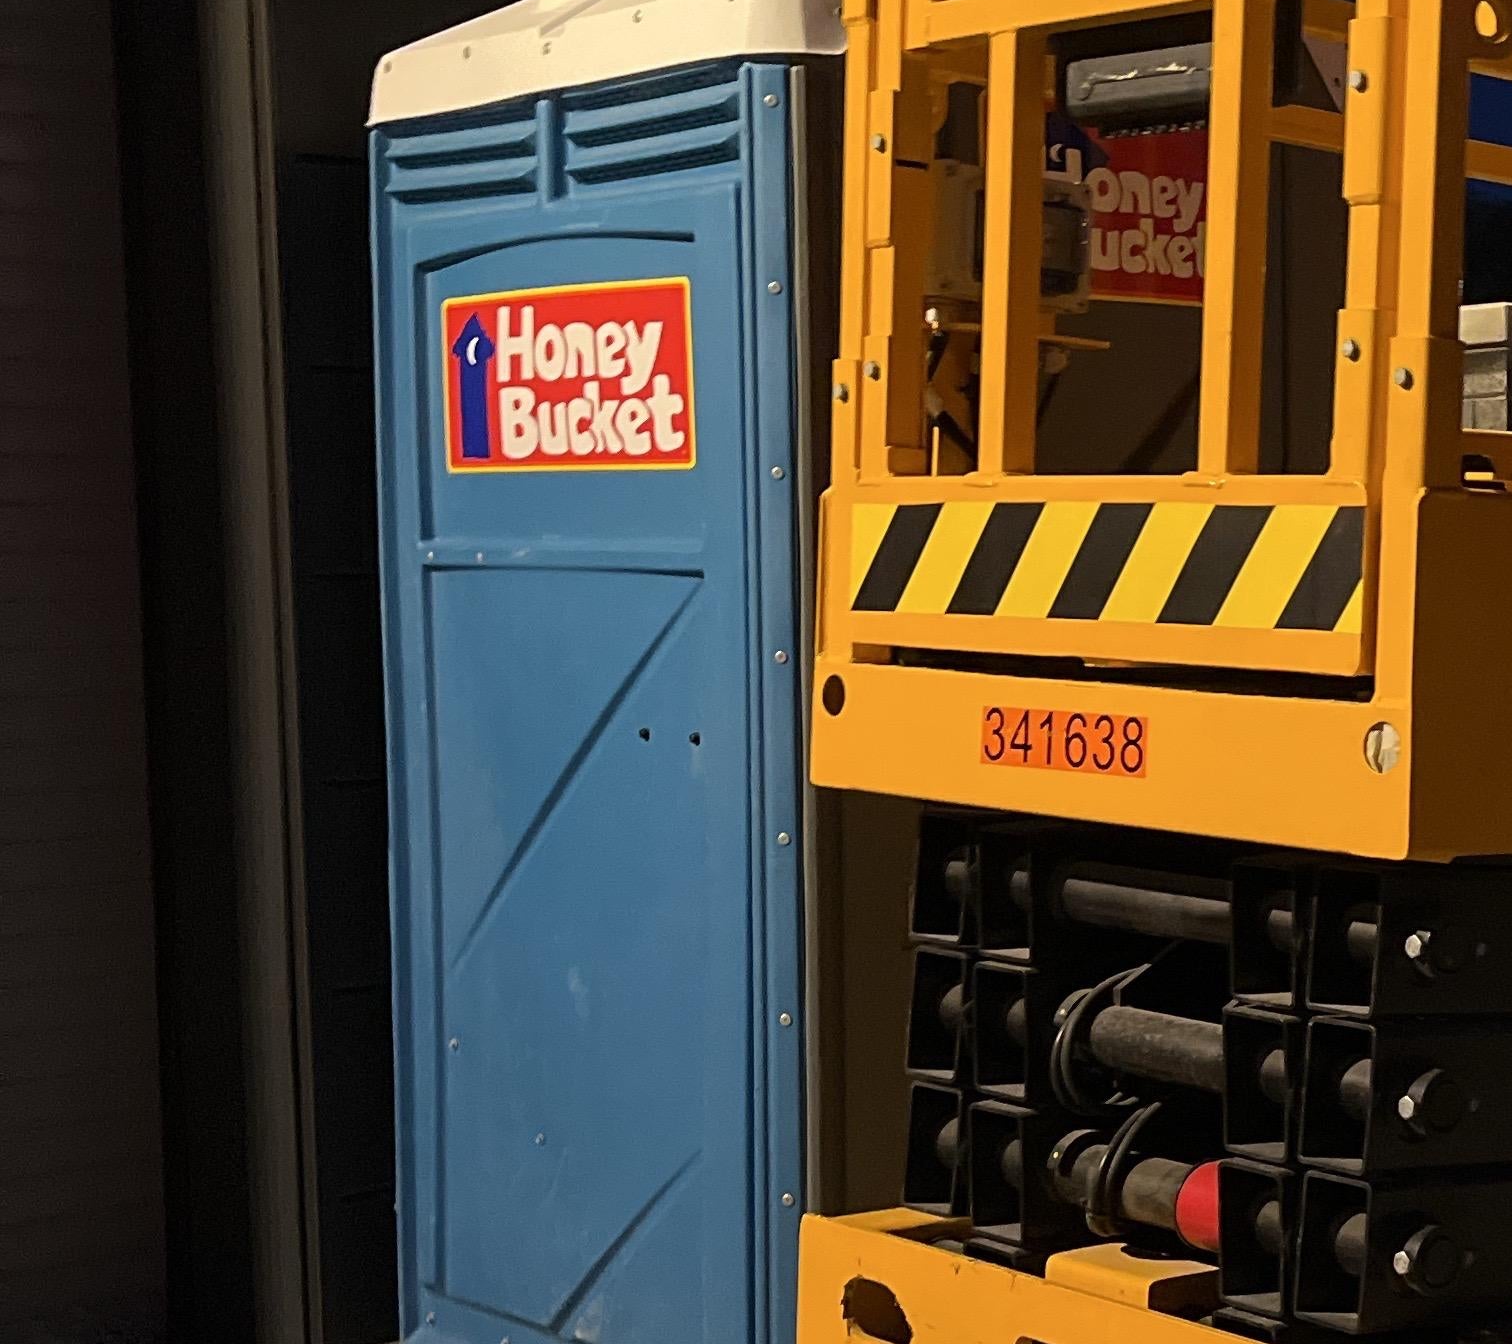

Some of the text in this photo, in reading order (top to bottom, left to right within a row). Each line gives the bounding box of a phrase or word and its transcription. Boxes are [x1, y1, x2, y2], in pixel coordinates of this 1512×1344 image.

[496, 304, 664, 396] Honey
[498, 373, 686, 460] Bucket
[983, 706, 1144, 774] 341638
